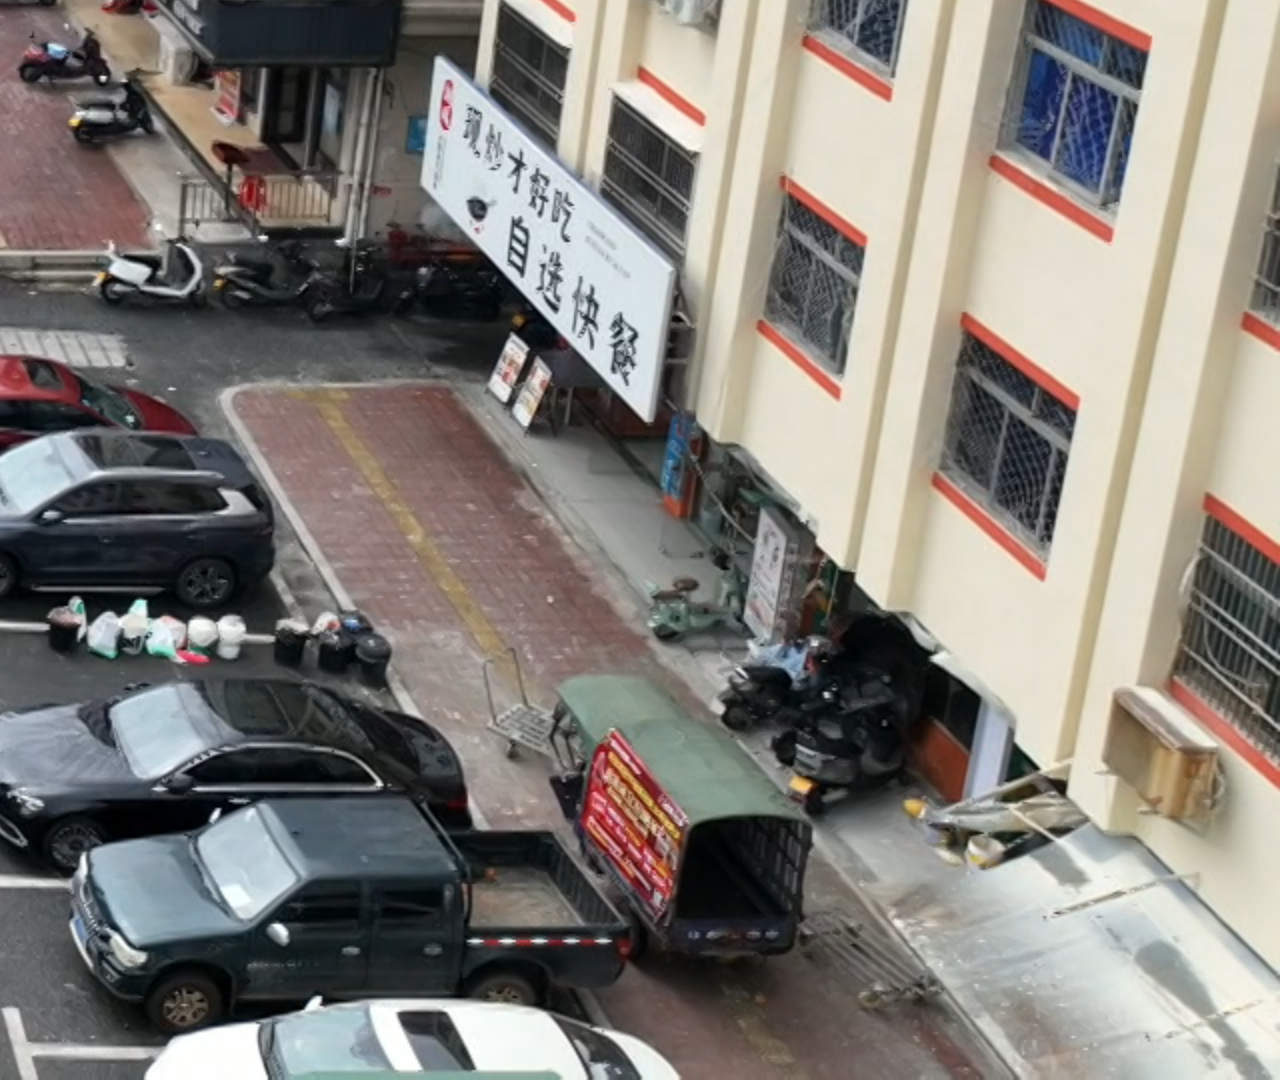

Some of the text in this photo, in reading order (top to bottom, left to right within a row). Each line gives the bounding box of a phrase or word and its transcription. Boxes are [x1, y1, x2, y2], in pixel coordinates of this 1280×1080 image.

[463, 103, 576, 243] 现炒才好吃
[507, 214, 639, 387] 自选快餐
